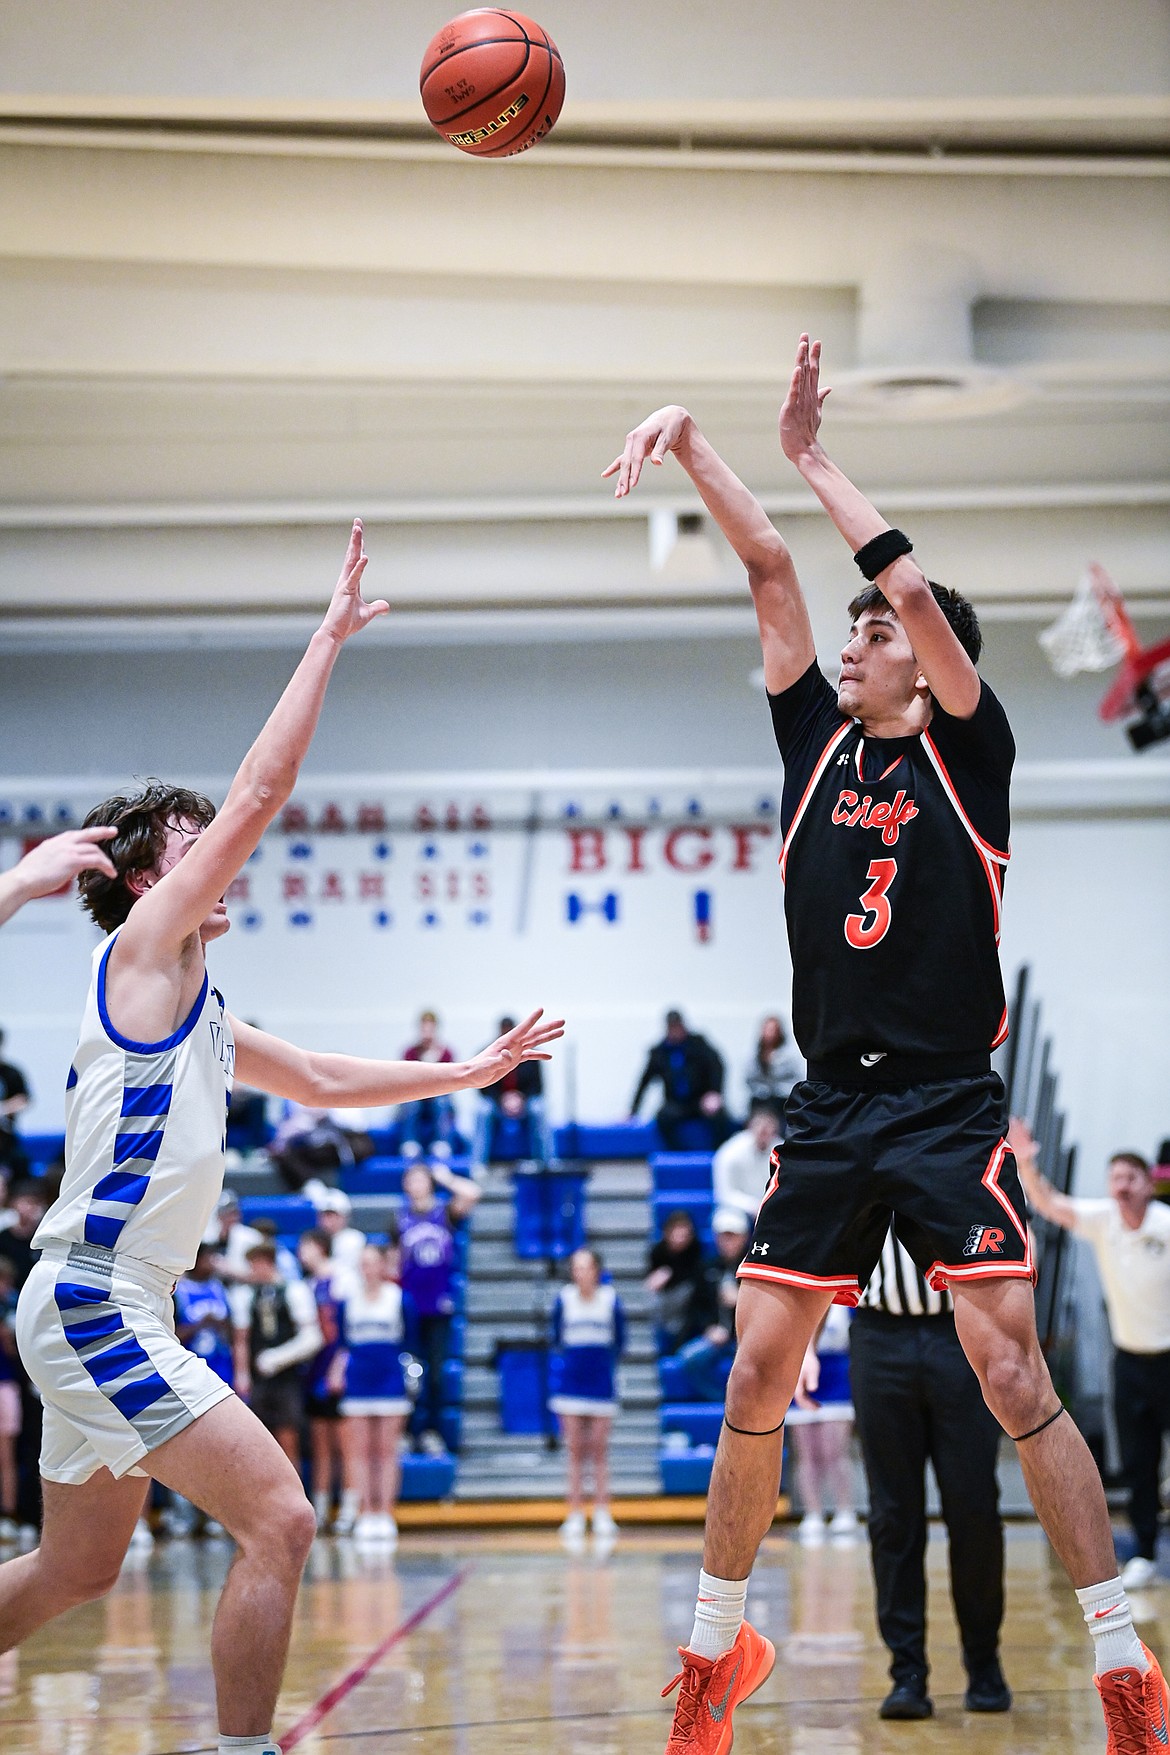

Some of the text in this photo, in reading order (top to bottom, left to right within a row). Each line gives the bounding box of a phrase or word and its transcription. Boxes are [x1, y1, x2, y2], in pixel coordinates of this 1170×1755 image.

[451, 84, 476, 104] GAME
[474, 92, 530, 138] ELITE
[844, 858, 898, 949] 3
